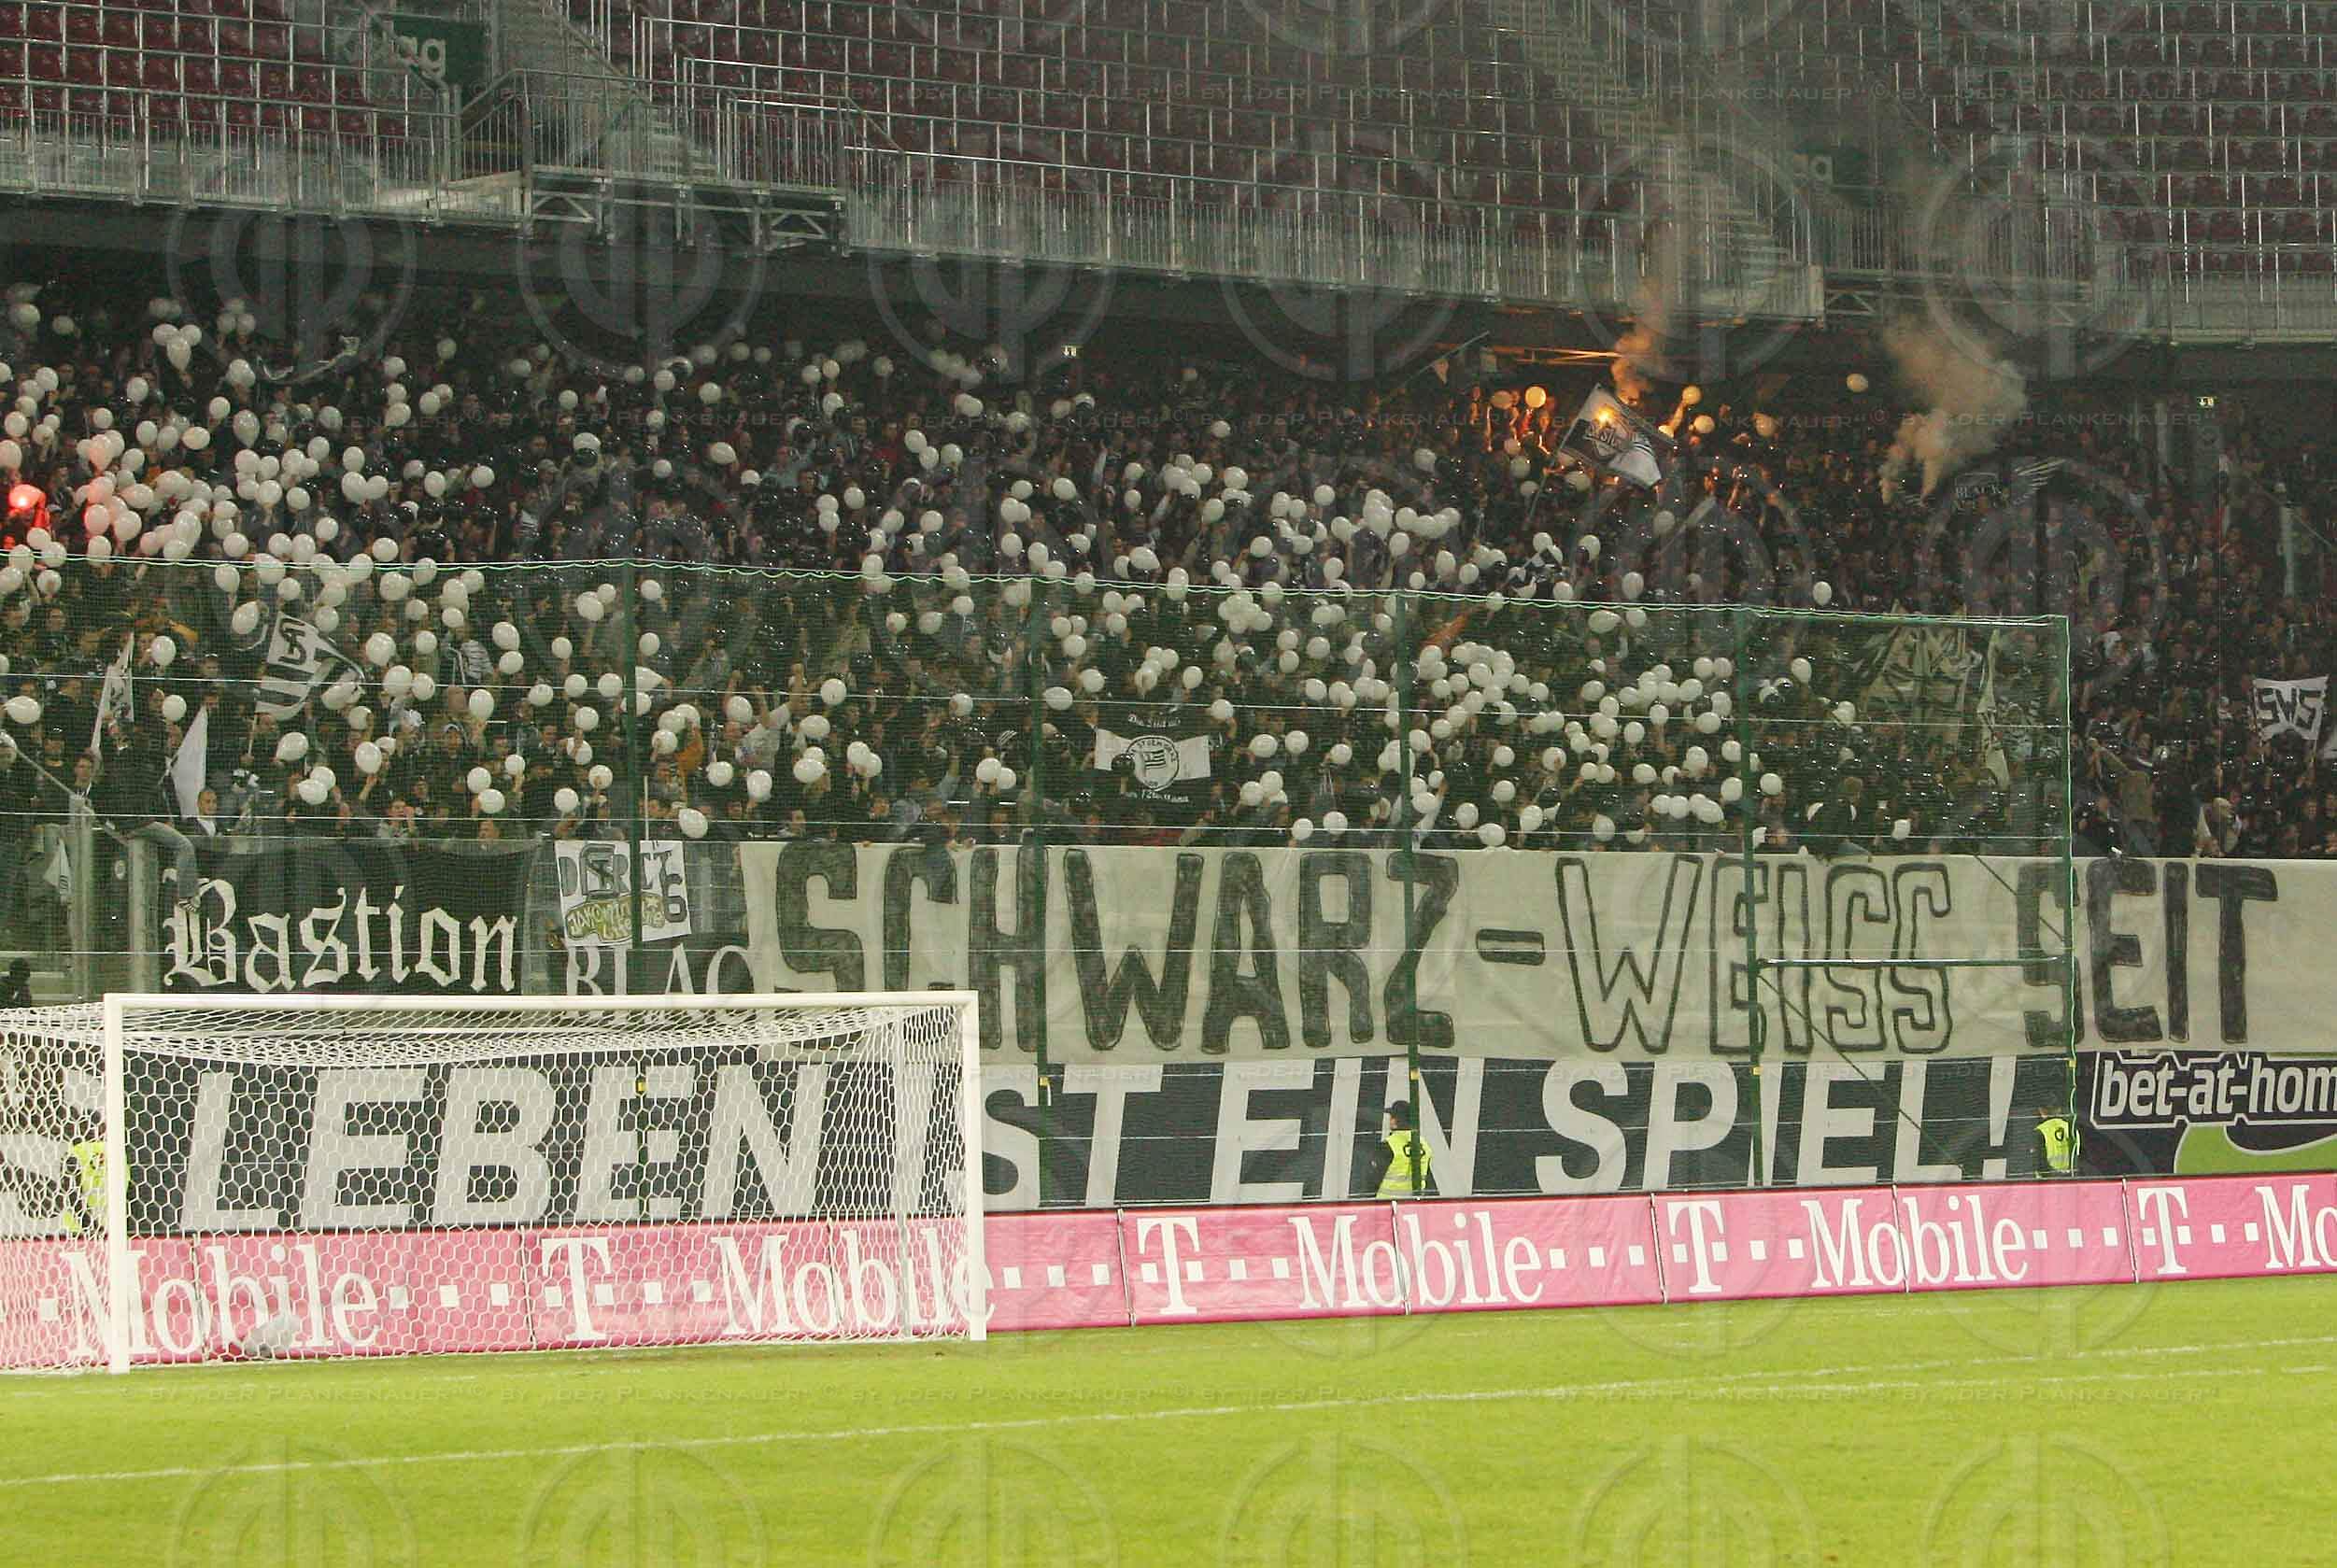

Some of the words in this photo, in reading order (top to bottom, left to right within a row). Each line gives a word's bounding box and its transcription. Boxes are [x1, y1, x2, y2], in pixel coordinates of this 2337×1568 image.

[163, 869, 517, 994] Bastion
[2017, 857, 2278, 1047] SEIT
[178, 1064, 831, 1231] LEBEN
[1211, 1055, 1484, 1204] EIN
[1535, 1054, 2017, 1195] SPIEL!
[1288, 1210, 1544, 1308] Mobile
[1802, 1194, 2027, 1289] Mobile
